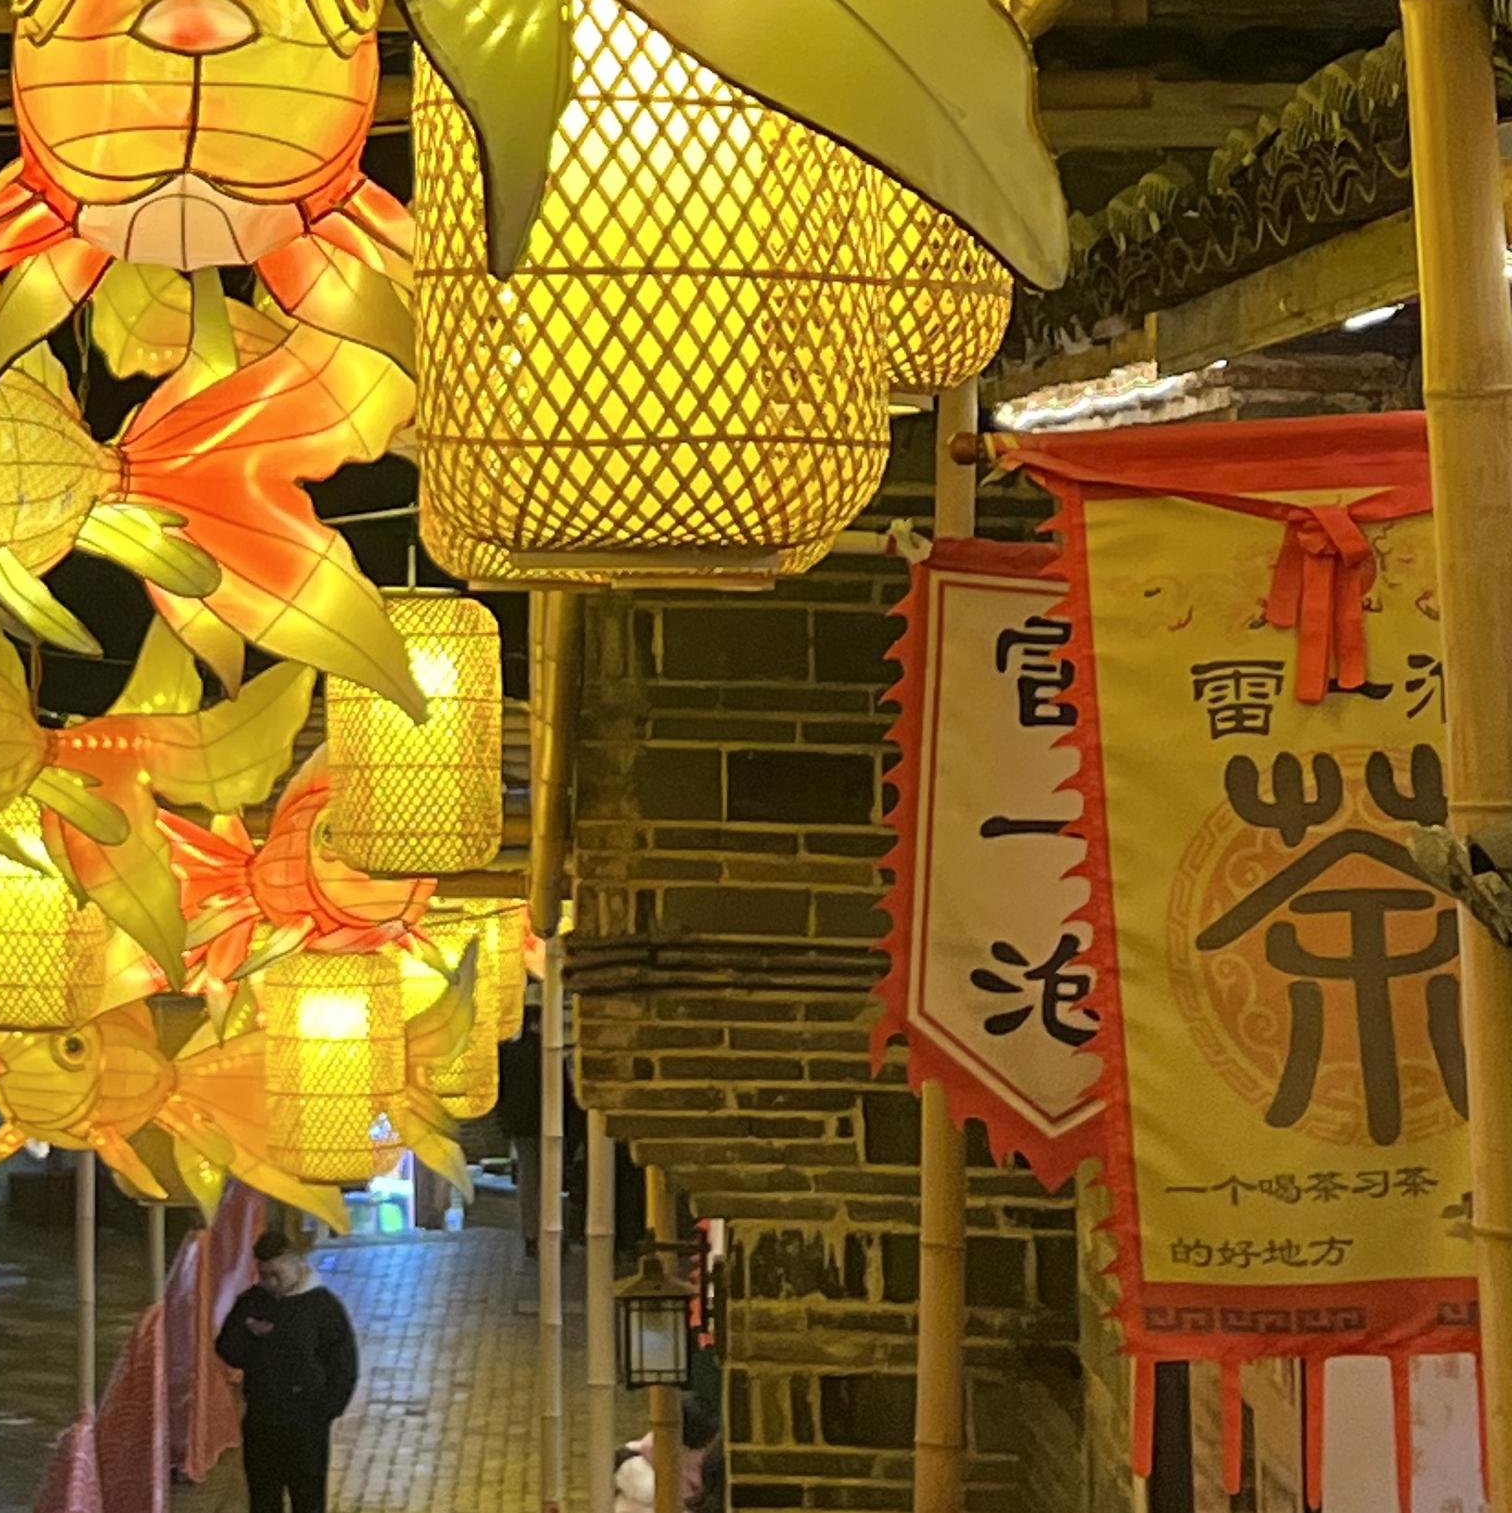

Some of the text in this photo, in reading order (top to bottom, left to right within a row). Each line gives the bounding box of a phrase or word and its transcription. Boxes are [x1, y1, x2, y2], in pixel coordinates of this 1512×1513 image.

[1164, 1166, 1439, 1206] 一个喝茶习茶
[1168, 1236, 1354, 1269] 的好地方
